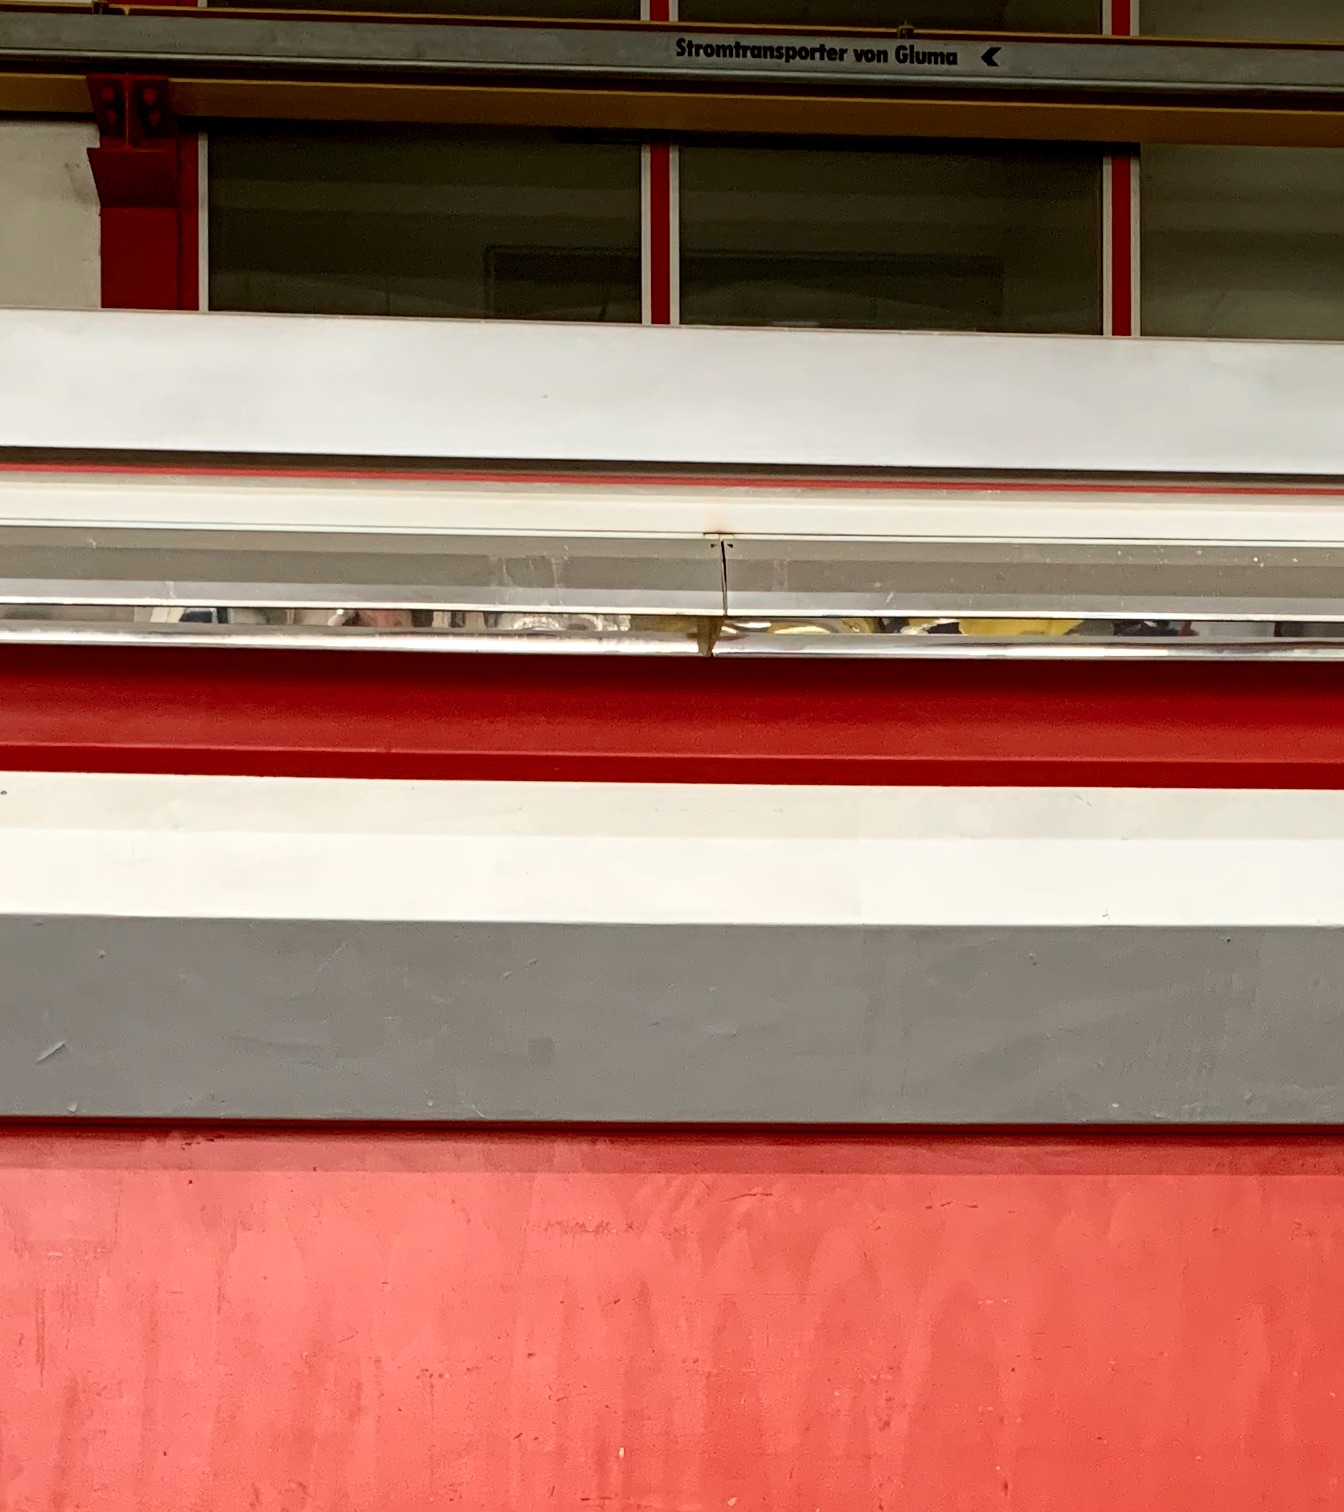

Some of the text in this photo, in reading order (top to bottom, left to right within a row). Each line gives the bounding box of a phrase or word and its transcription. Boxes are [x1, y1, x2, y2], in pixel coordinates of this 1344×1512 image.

[676, 38, 958, 65] Stromtransporter von Gluma
